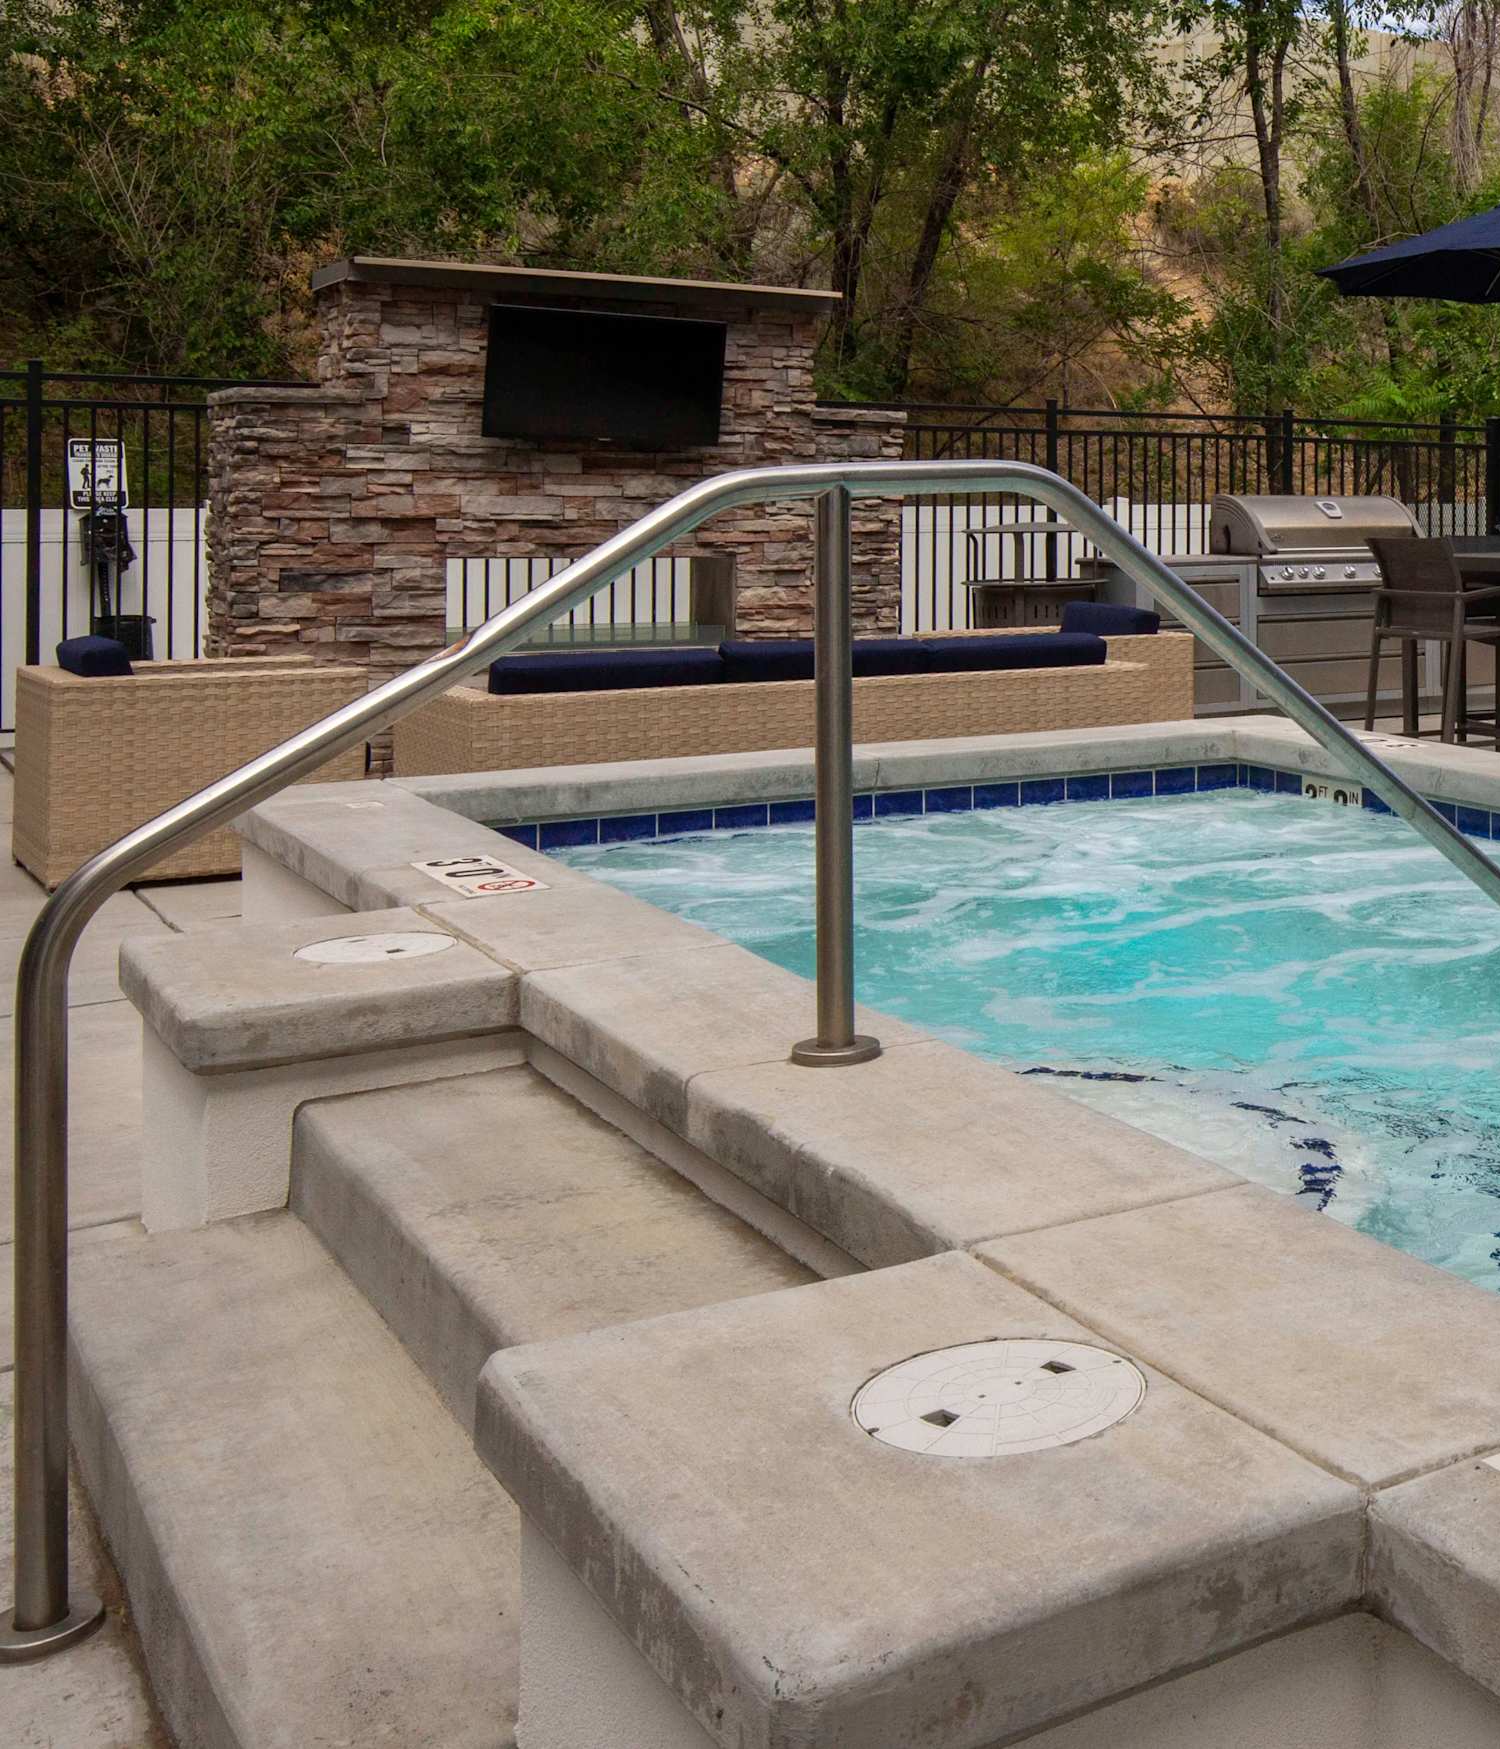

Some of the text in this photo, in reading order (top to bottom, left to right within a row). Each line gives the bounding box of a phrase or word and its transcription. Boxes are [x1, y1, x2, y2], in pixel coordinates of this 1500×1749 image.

[73, 444, 89, 452] PET
[1349, 791, 1359, 805] IN
[426, 857, 482, 867] 3
[445, 868, 504, 878] 0
